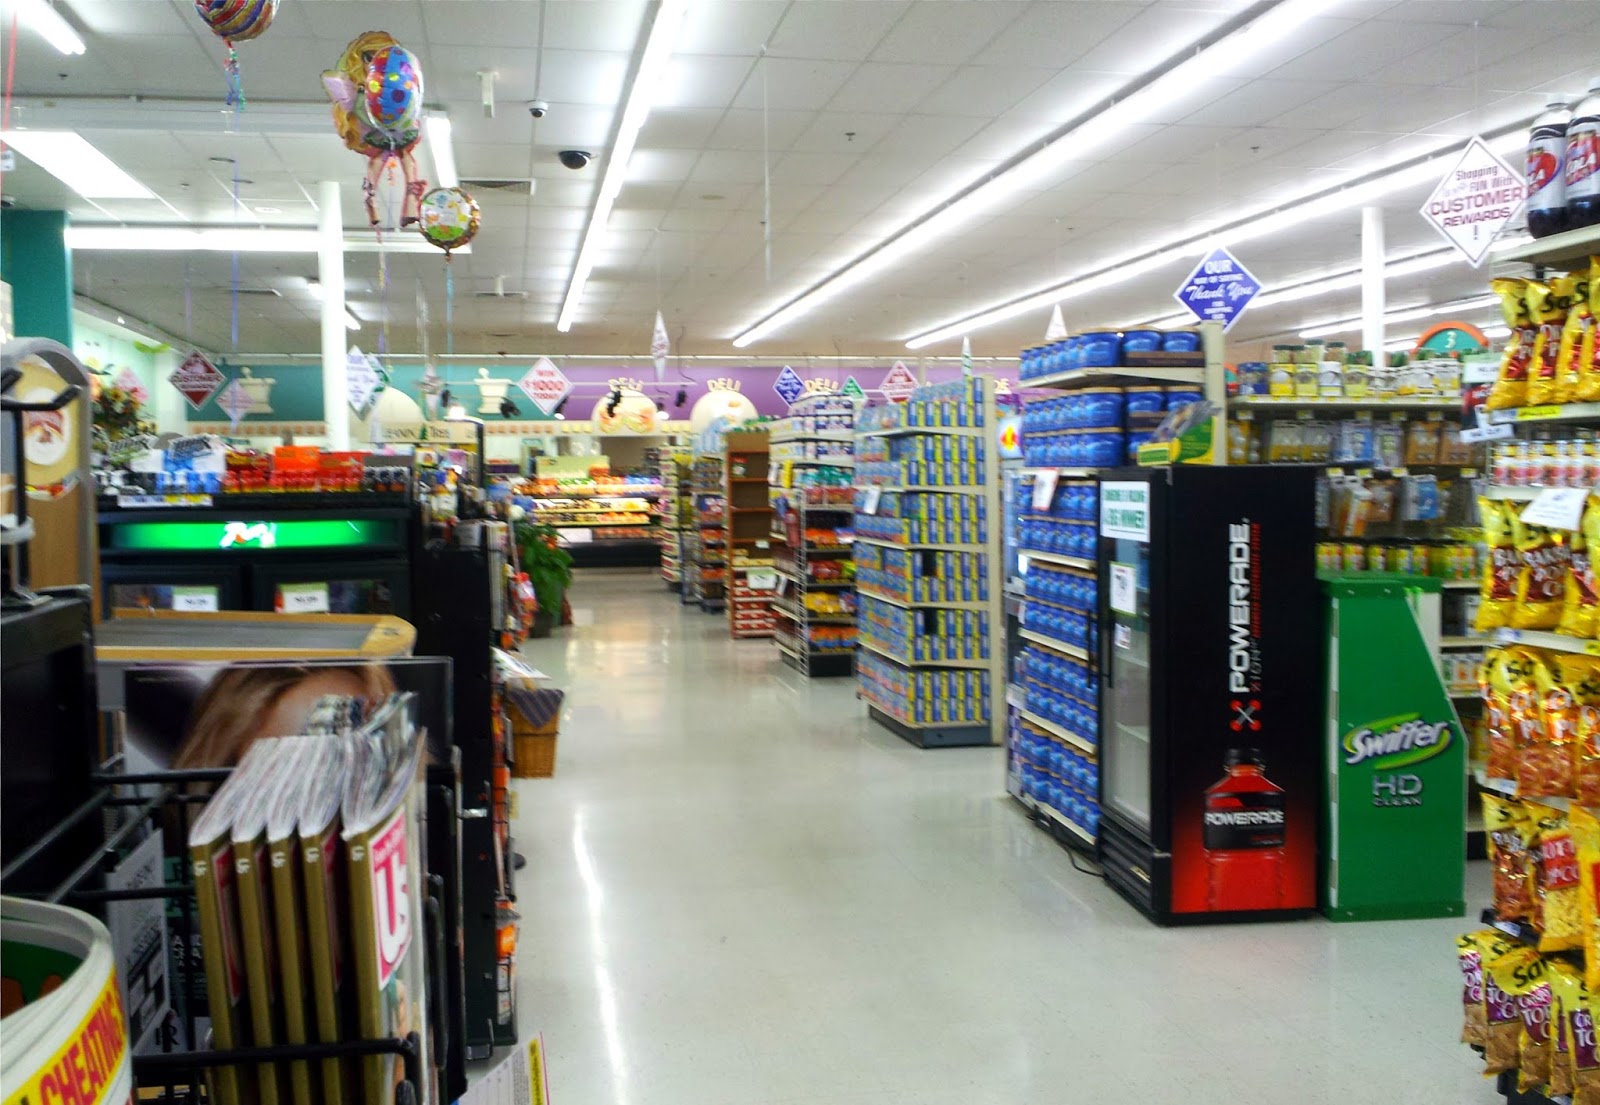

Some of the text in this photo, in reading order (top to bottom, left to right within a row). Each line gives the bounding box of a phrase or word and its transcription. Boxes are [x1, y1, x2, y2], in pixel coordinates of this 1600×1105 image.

[1430, 186, 1524, 215] CUSTOMER
[1443, 206, 1512, 228] REWARDS
[1204, 260, 1233, 275] OUR
[1185, 281, 1255, 301] Thank You
[706, 377, 742, 393] DELI
[804, 377, 840, 393] DELI
[1228, 523, 1250, 692] POWERADE
[1345, 719, 1449, 764] Swiffer
[1371, 774, 1423, 796] HD
[1373, 796, 1422, 807] CLEAN
[1204, 811, 1285, 826] POWERADE
[39, 974, 127, 1105] CHEATIN
